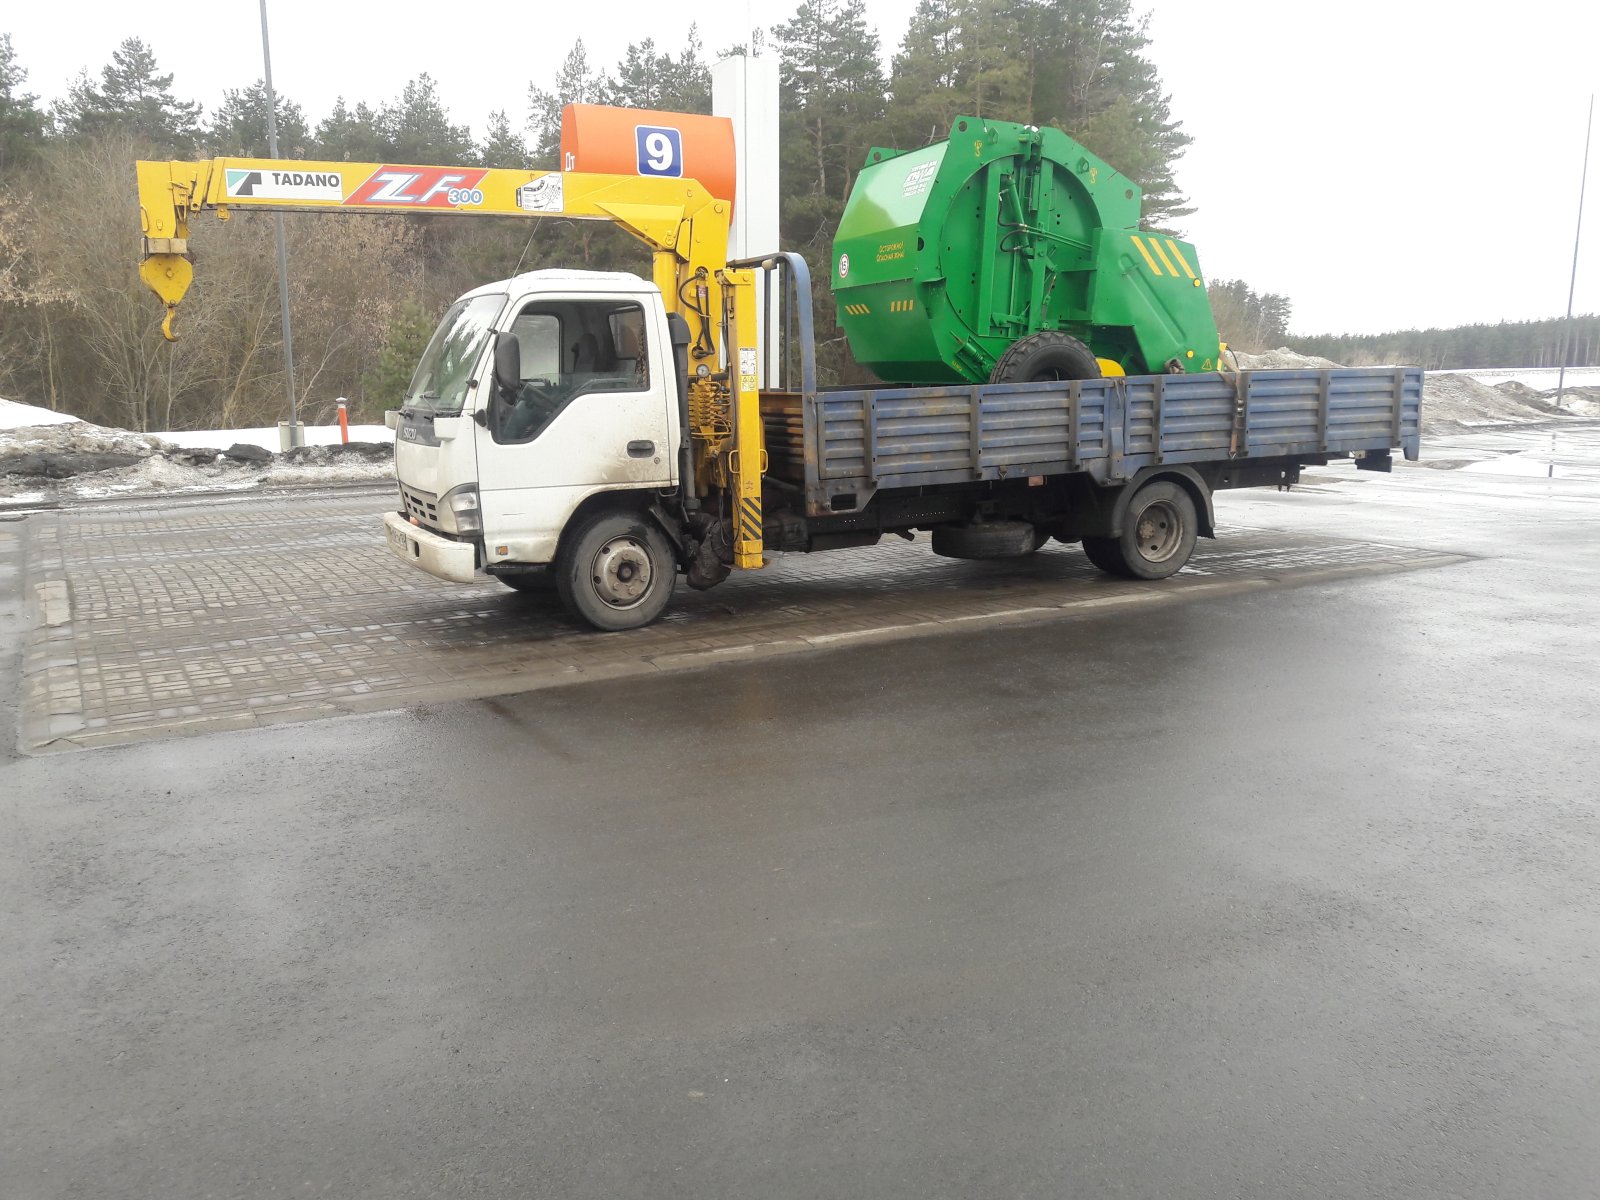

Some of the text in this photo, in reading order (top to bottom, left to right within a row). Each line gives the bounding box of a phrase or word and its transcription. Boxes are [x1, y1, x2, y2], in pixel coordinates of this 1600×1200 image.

[645, 132, 674, 172] 9
[271, 172, 341, 188] TADANO
[447, 187, 484, 205] 300
